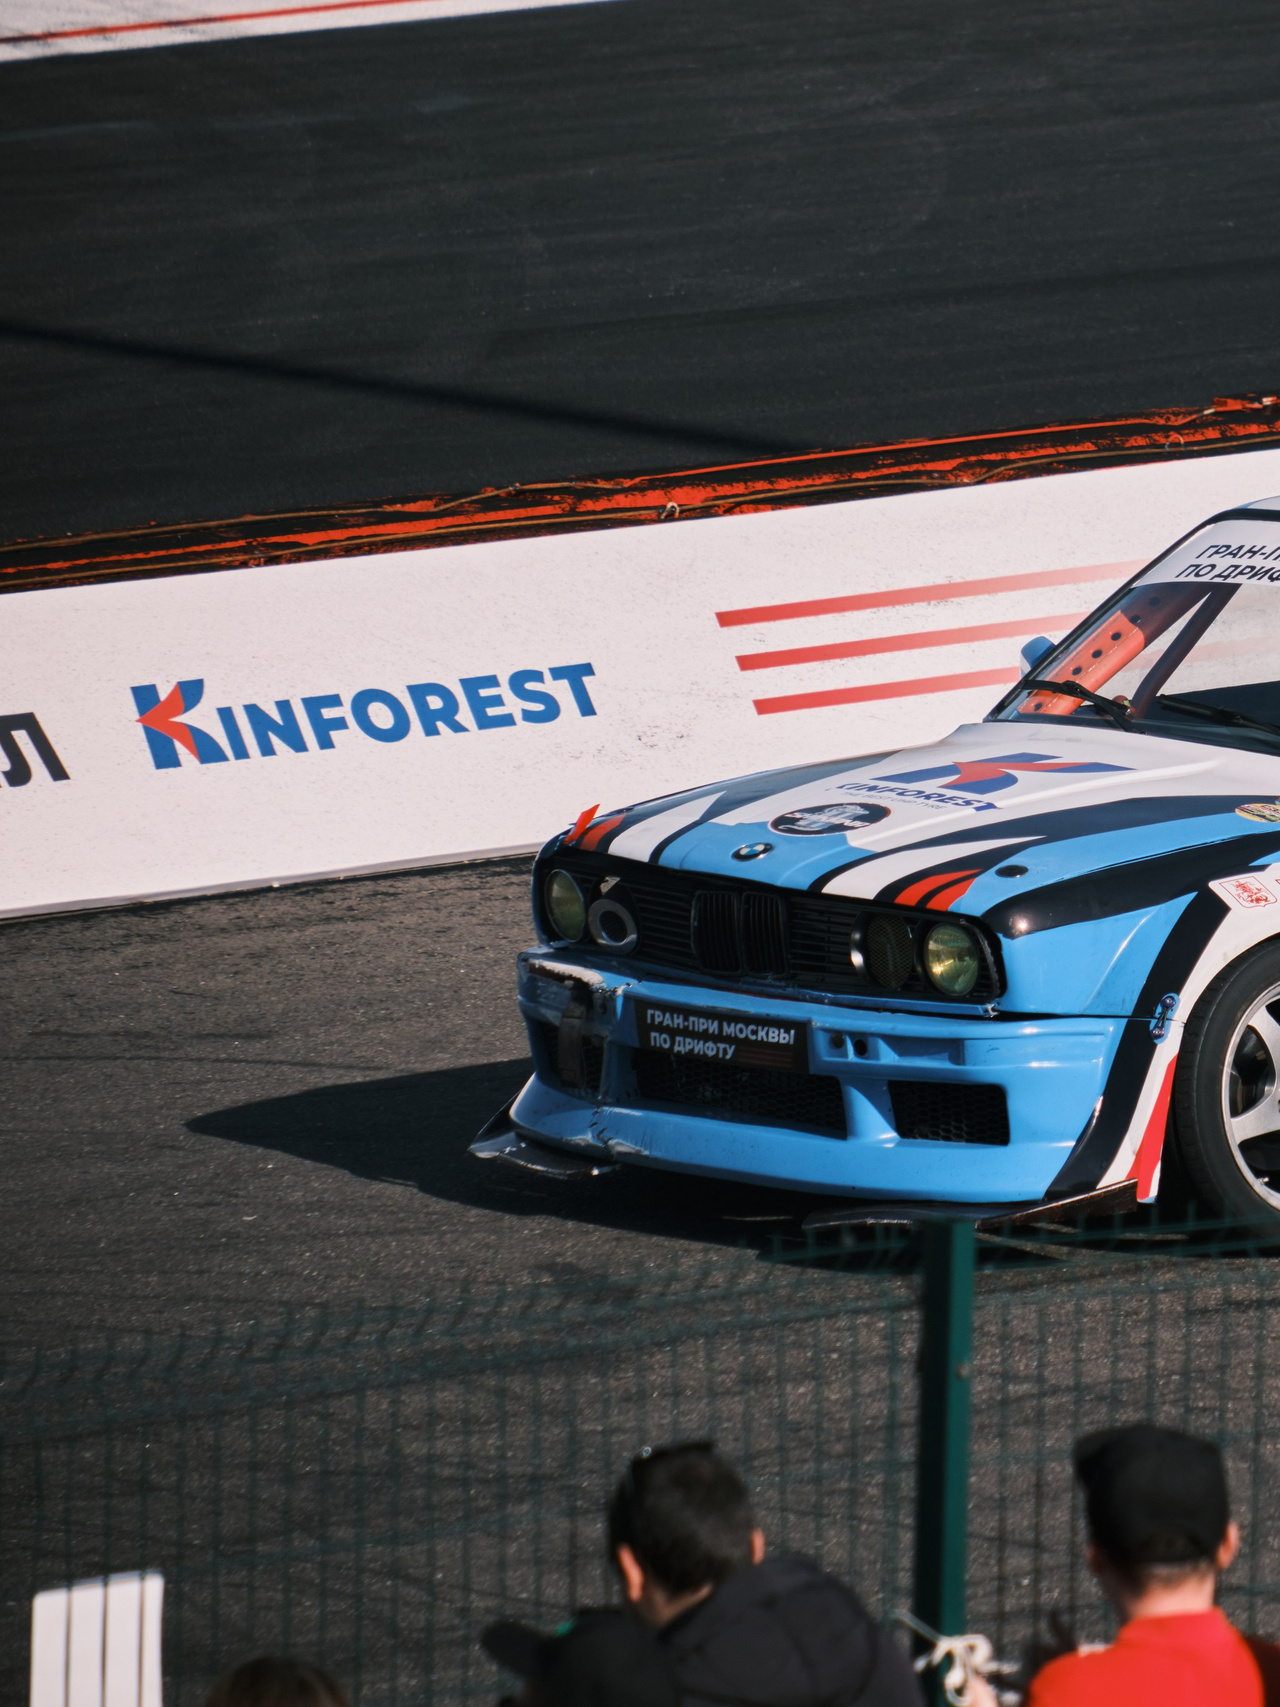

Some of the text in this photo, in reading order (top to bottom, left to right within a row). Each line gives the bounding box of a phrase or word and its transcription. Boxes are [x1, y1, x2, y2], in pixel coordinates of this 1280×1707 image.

[1175, 563, 1212, 580] ПО
[131, 662, 596, 770] KINFOREST
[646, 1009, 796, 1045] ГРАН-ПРИ МОСКВЫ
[650, 1031, 736, 1060] ПО ДРИФТУ
